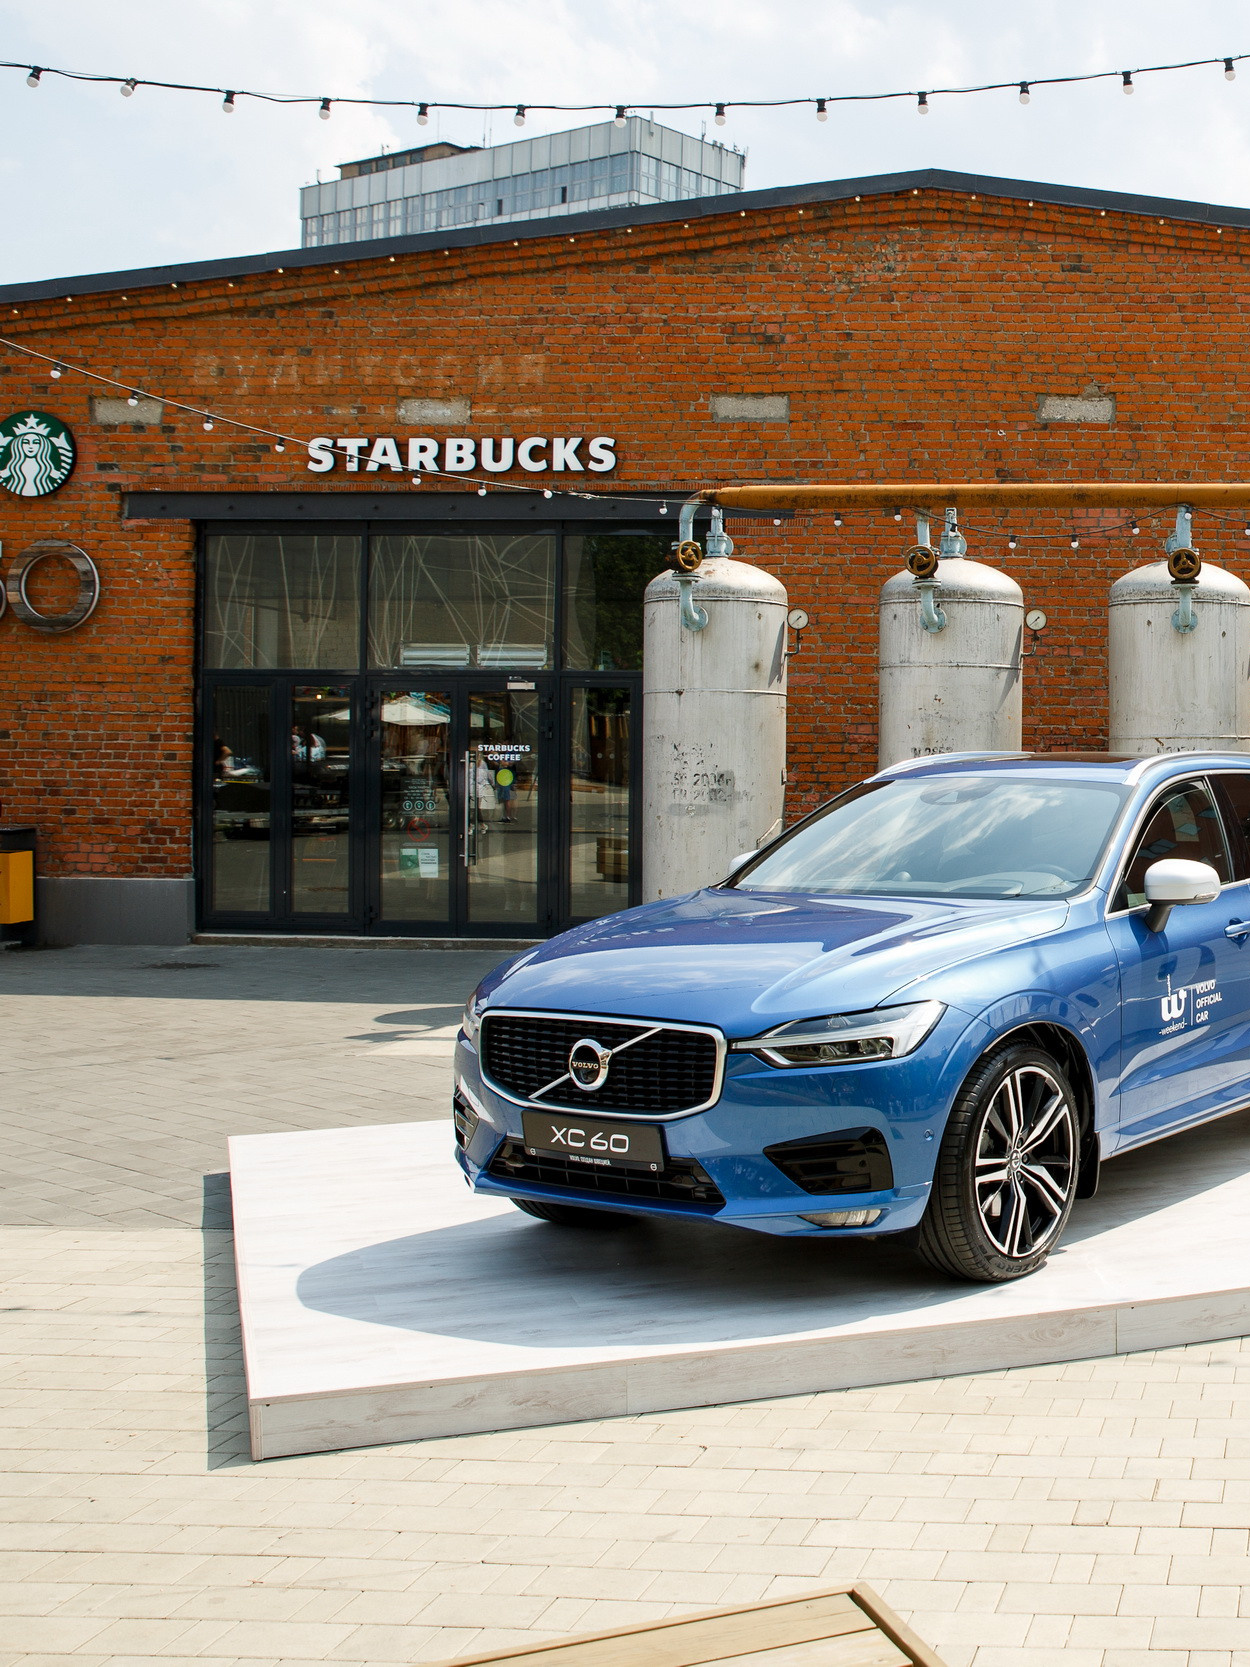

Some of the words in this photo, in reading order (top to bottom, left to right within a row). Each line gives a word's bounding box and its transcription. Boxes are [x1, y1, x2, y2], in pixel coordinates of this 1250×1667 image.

[307, 436, 617, 473] STARBUCKS
[477, 743, 531, 752] STARBUCKS
[487, 753, 521, 761] COFFEE
[1195, 979, 1217, 995] VOLVO
[1196, 991, 1223, 1009] OFFICIAL
[1195, 1010, 1209, 1023] CAR
[571, 1061, 599, 1069] VOLVO
[550, 1125, 586, 1148] XC
[590, 1131, 630, 1153] 60
